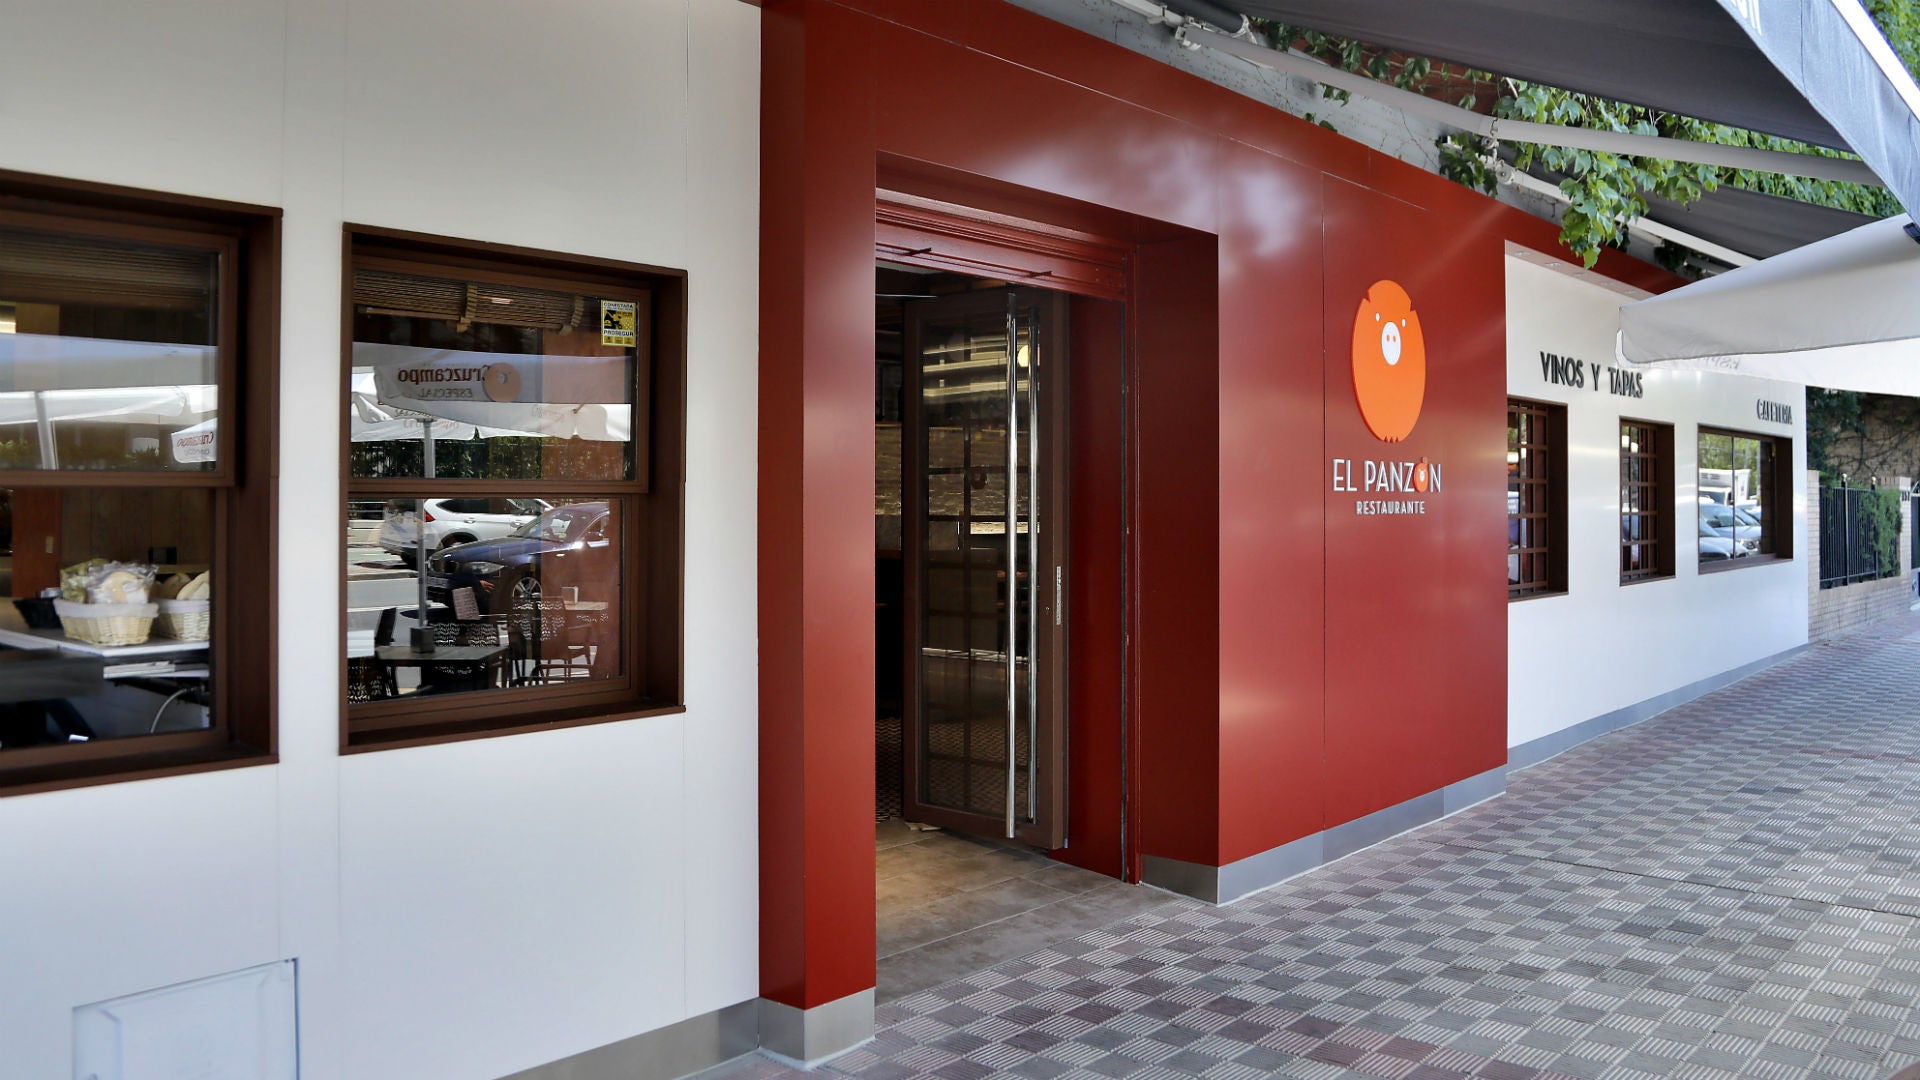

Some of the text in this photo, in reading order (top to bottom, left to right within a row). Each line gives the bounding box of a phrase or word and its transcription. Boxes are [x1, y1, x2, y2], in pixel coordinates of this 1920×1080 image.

[1540, 351, 1643, 399] VINOS Y TAPAS
[1332, 458, 1358, 492] EL
[1356, 500, 1425, 515] RESTAURANTE
